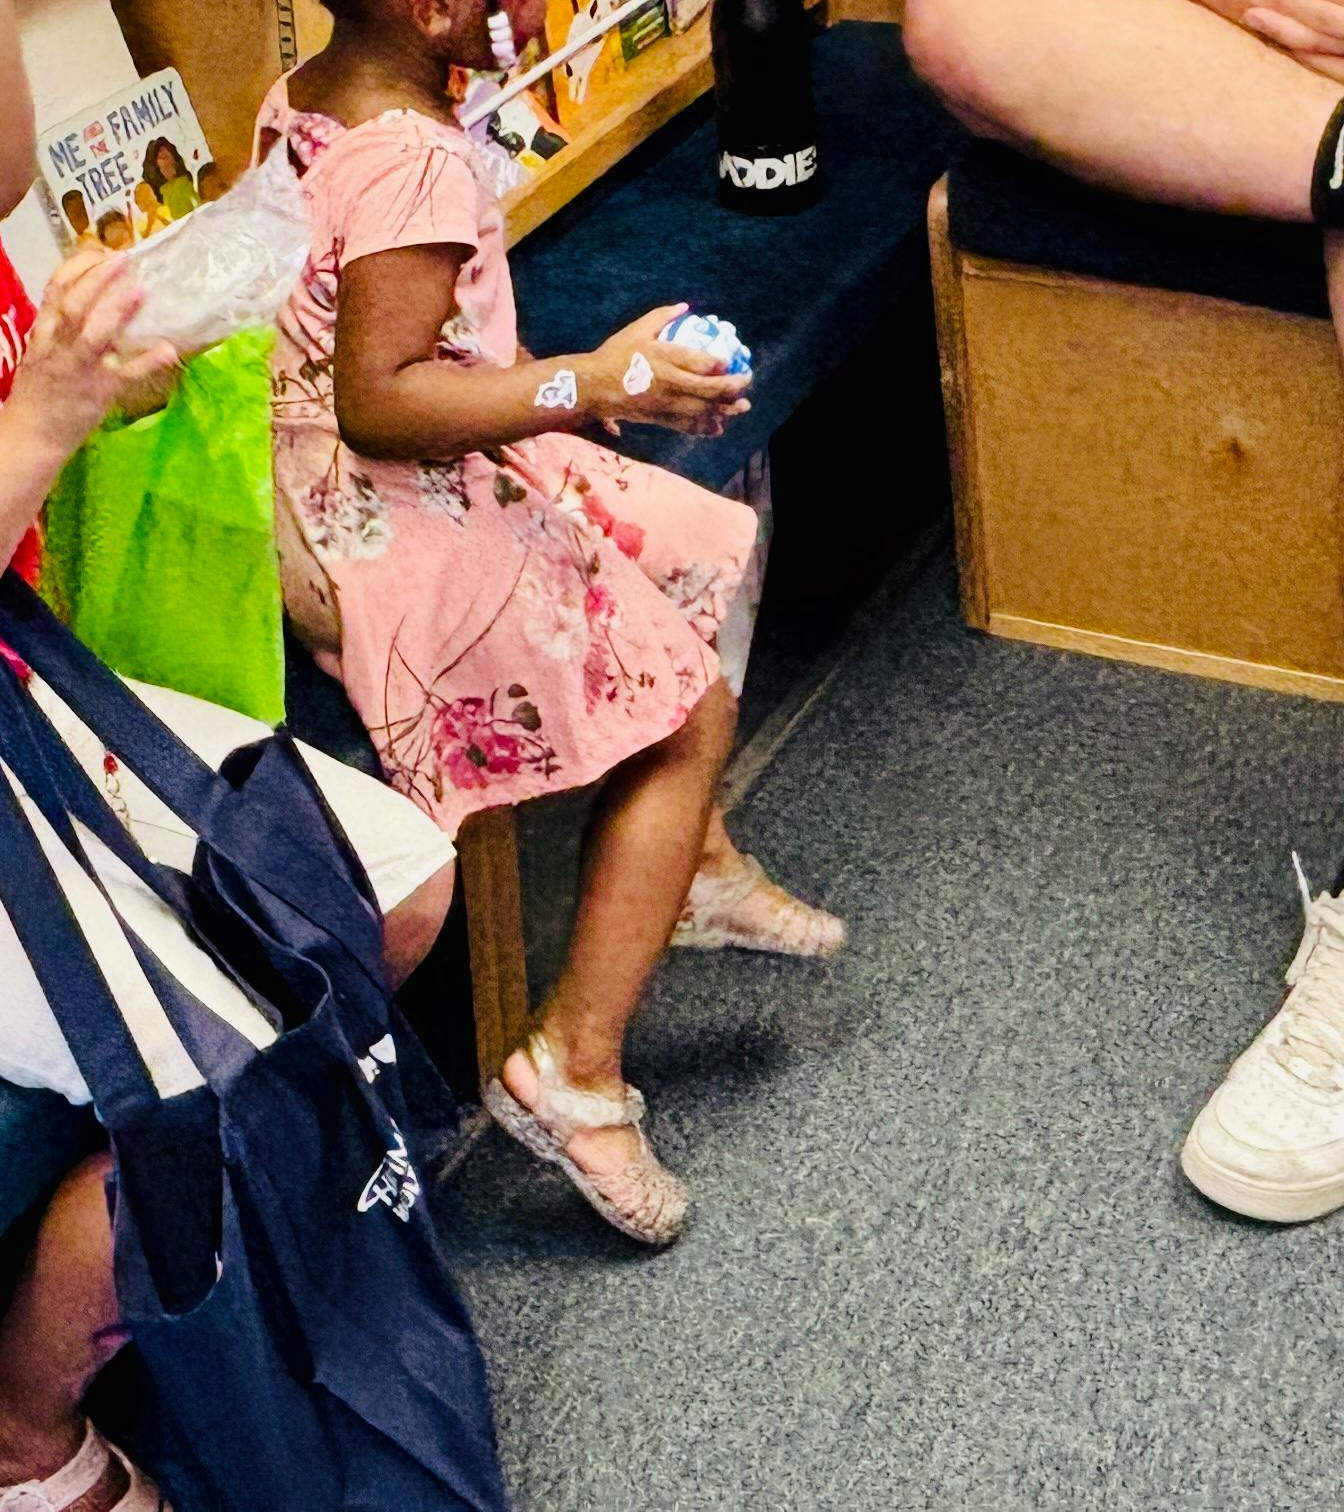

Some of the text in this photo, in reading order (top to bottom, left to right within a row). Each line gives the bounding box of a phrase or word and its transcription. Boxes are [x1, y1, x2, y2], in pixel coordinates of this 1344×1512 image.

[47, 132, 87, 179] ME
[106, 80, 181, 146] FAMILY
[76, 150, 135, 208] TREE
